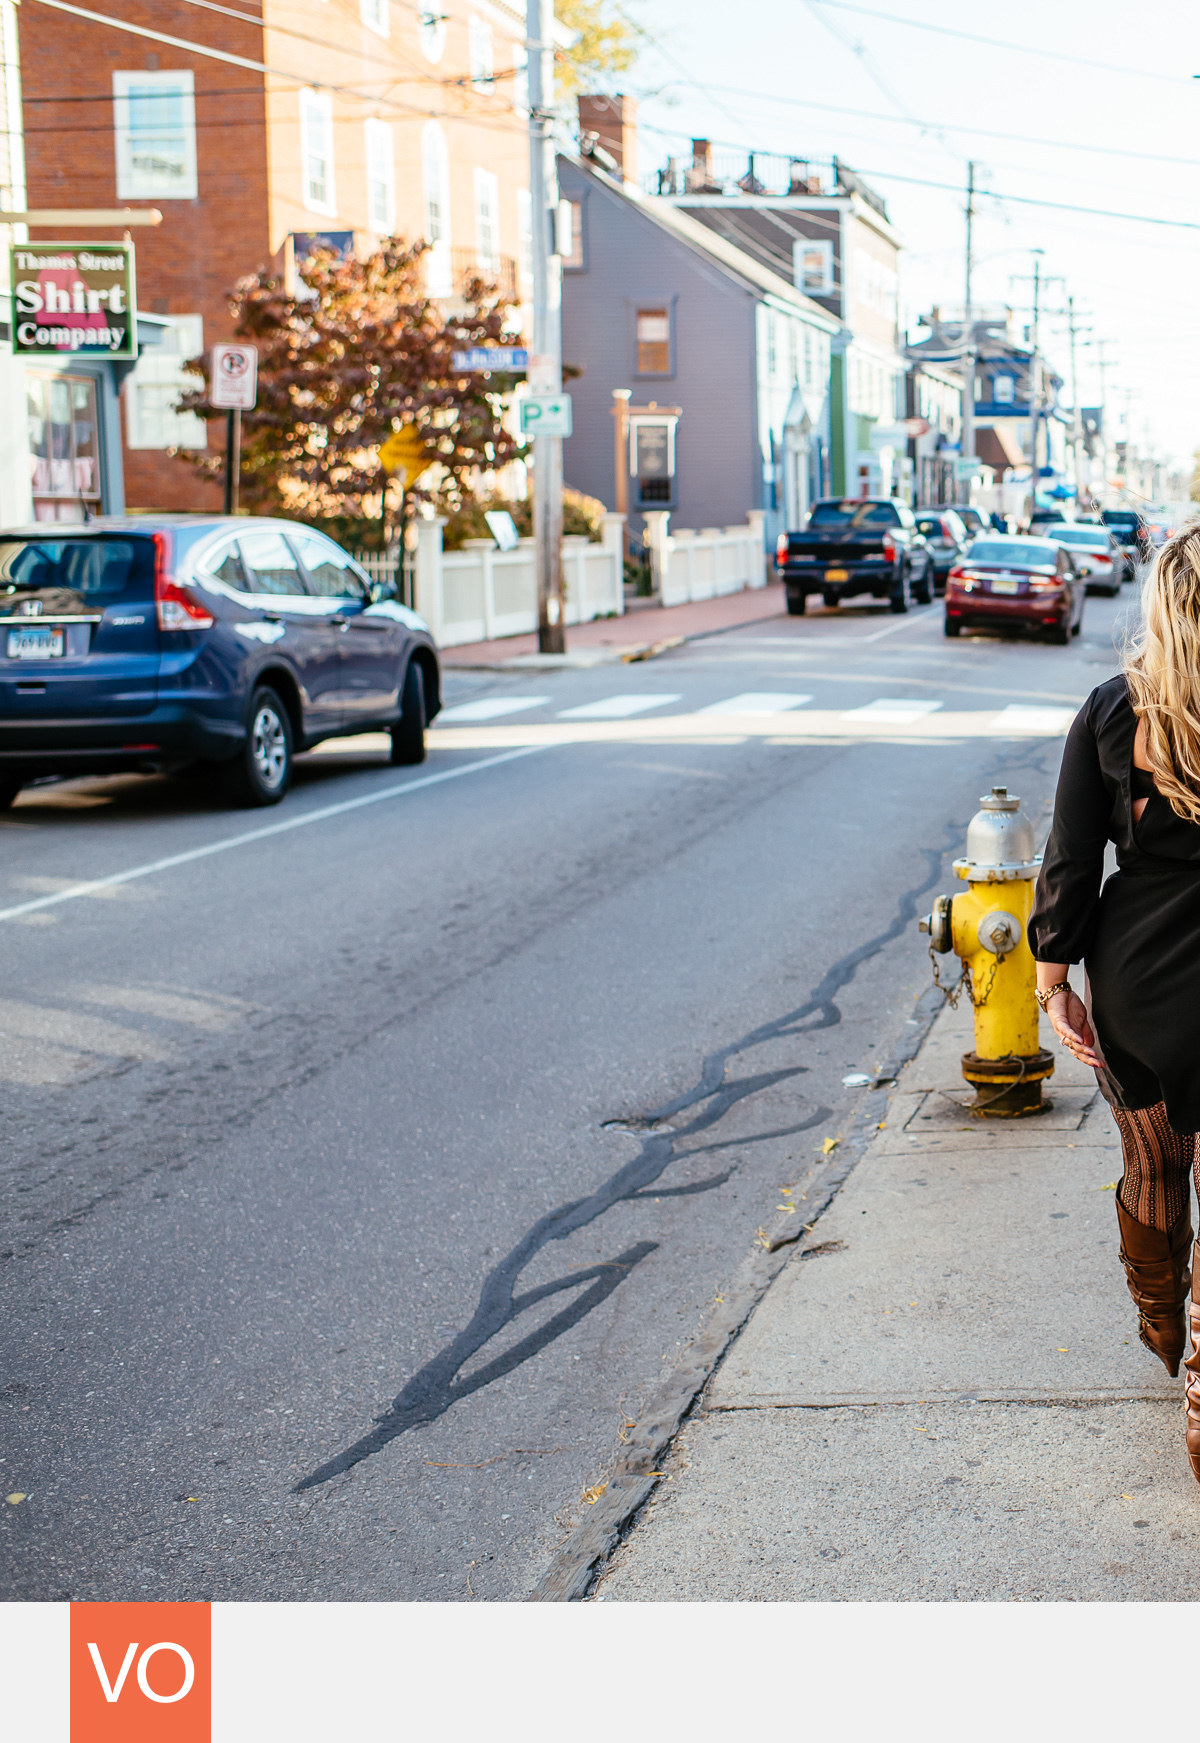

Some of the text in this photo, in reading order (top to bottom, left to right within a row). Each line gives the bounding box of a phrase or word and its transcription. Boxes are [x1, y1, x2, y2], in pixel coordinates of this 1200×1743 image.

[14, 251, 125, 271] Thames Street
[15, 280, 126, 314] Shirt
[17, 322, 125, 350] Company
[523, 403, 543, 429] P
